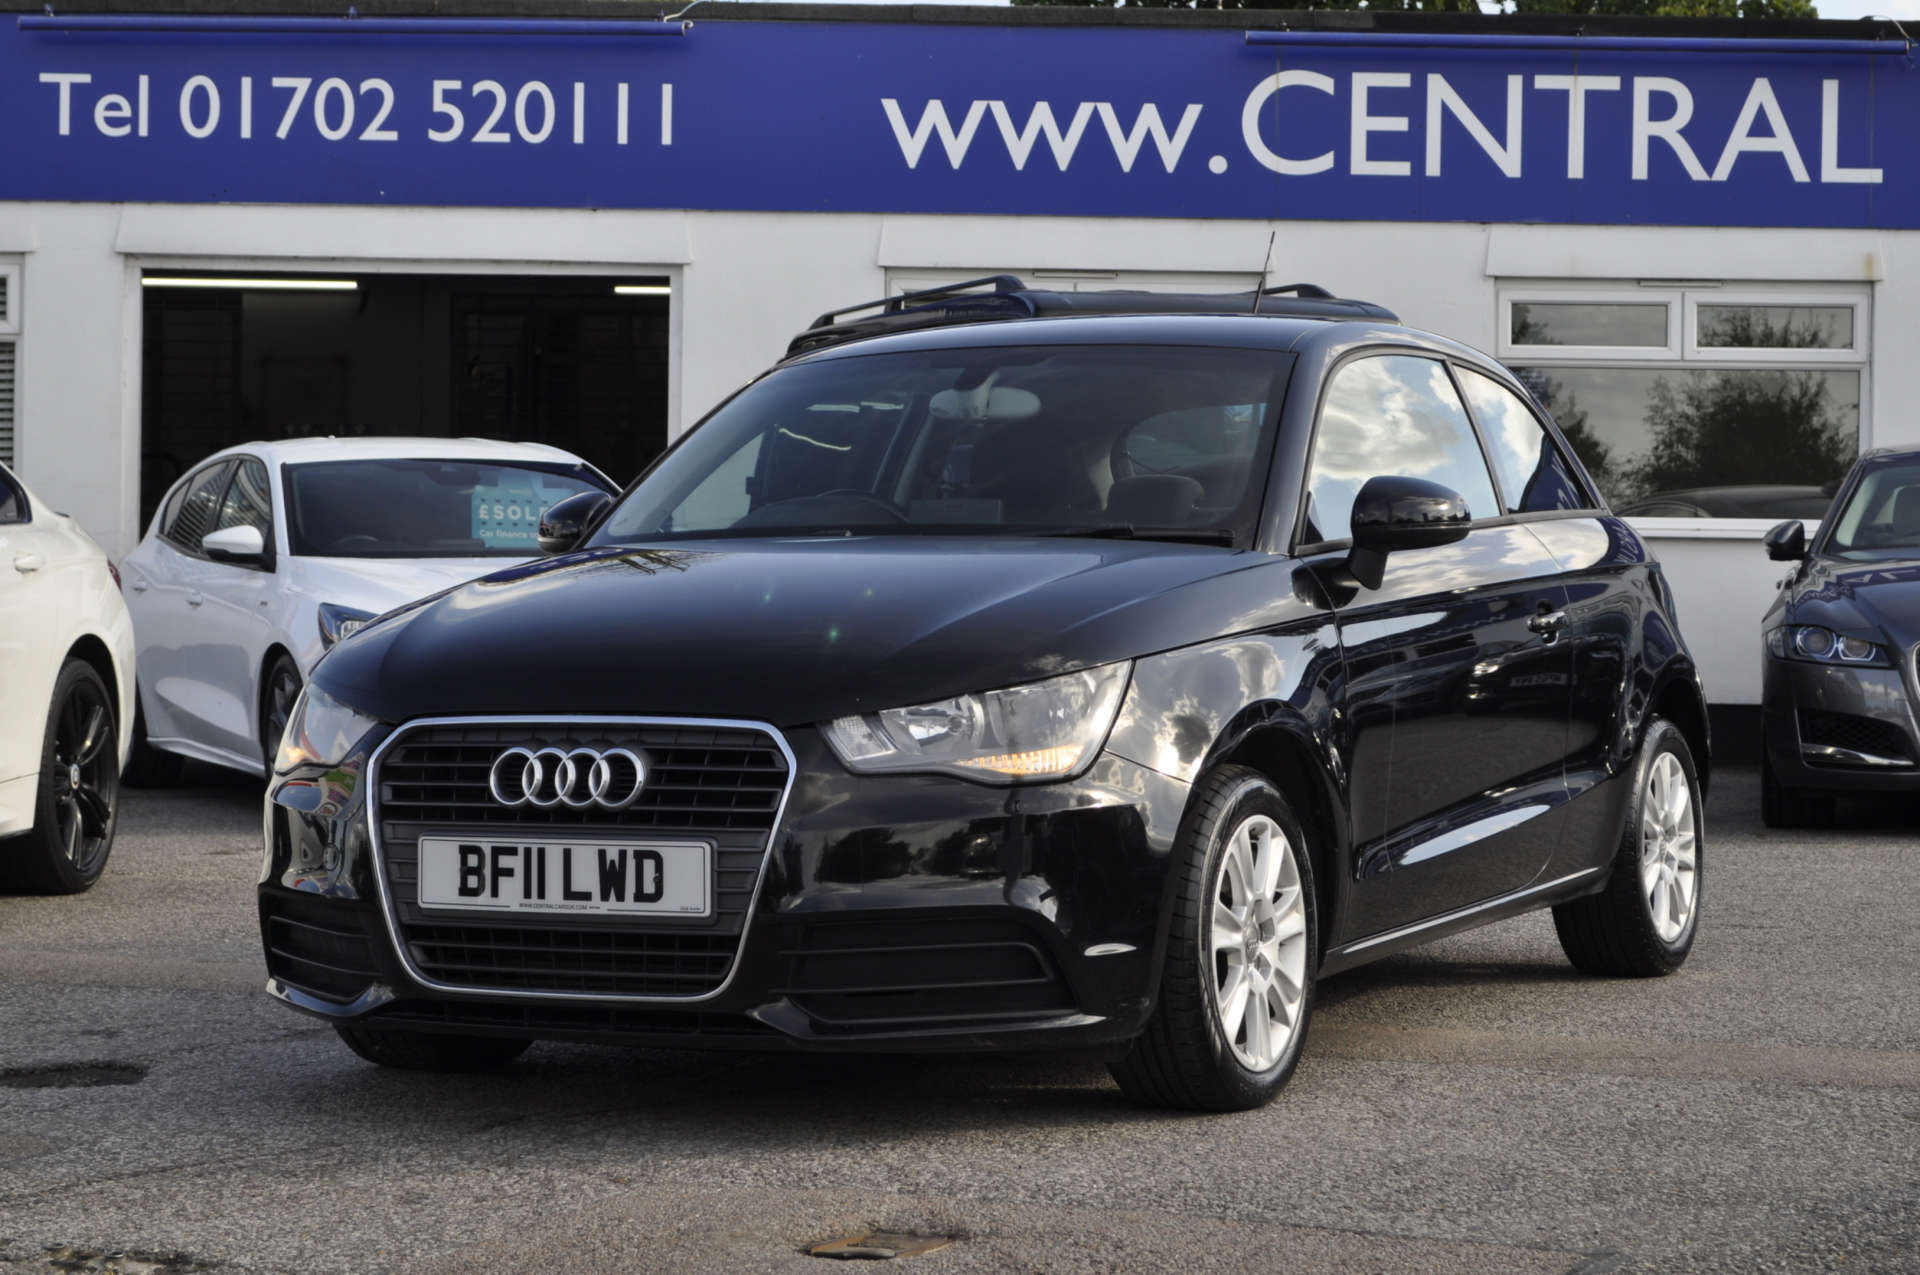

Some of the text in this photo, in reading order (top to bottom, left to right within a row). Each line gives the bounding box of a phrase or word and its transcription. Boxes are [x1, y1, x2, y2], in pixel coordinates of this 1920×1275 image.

[39, 73, 672, 145] Tel 01702 520111
[881, 70, 1883, 184] www.CENTRAL
[459, 844, 664, 903] BF11 LWD
